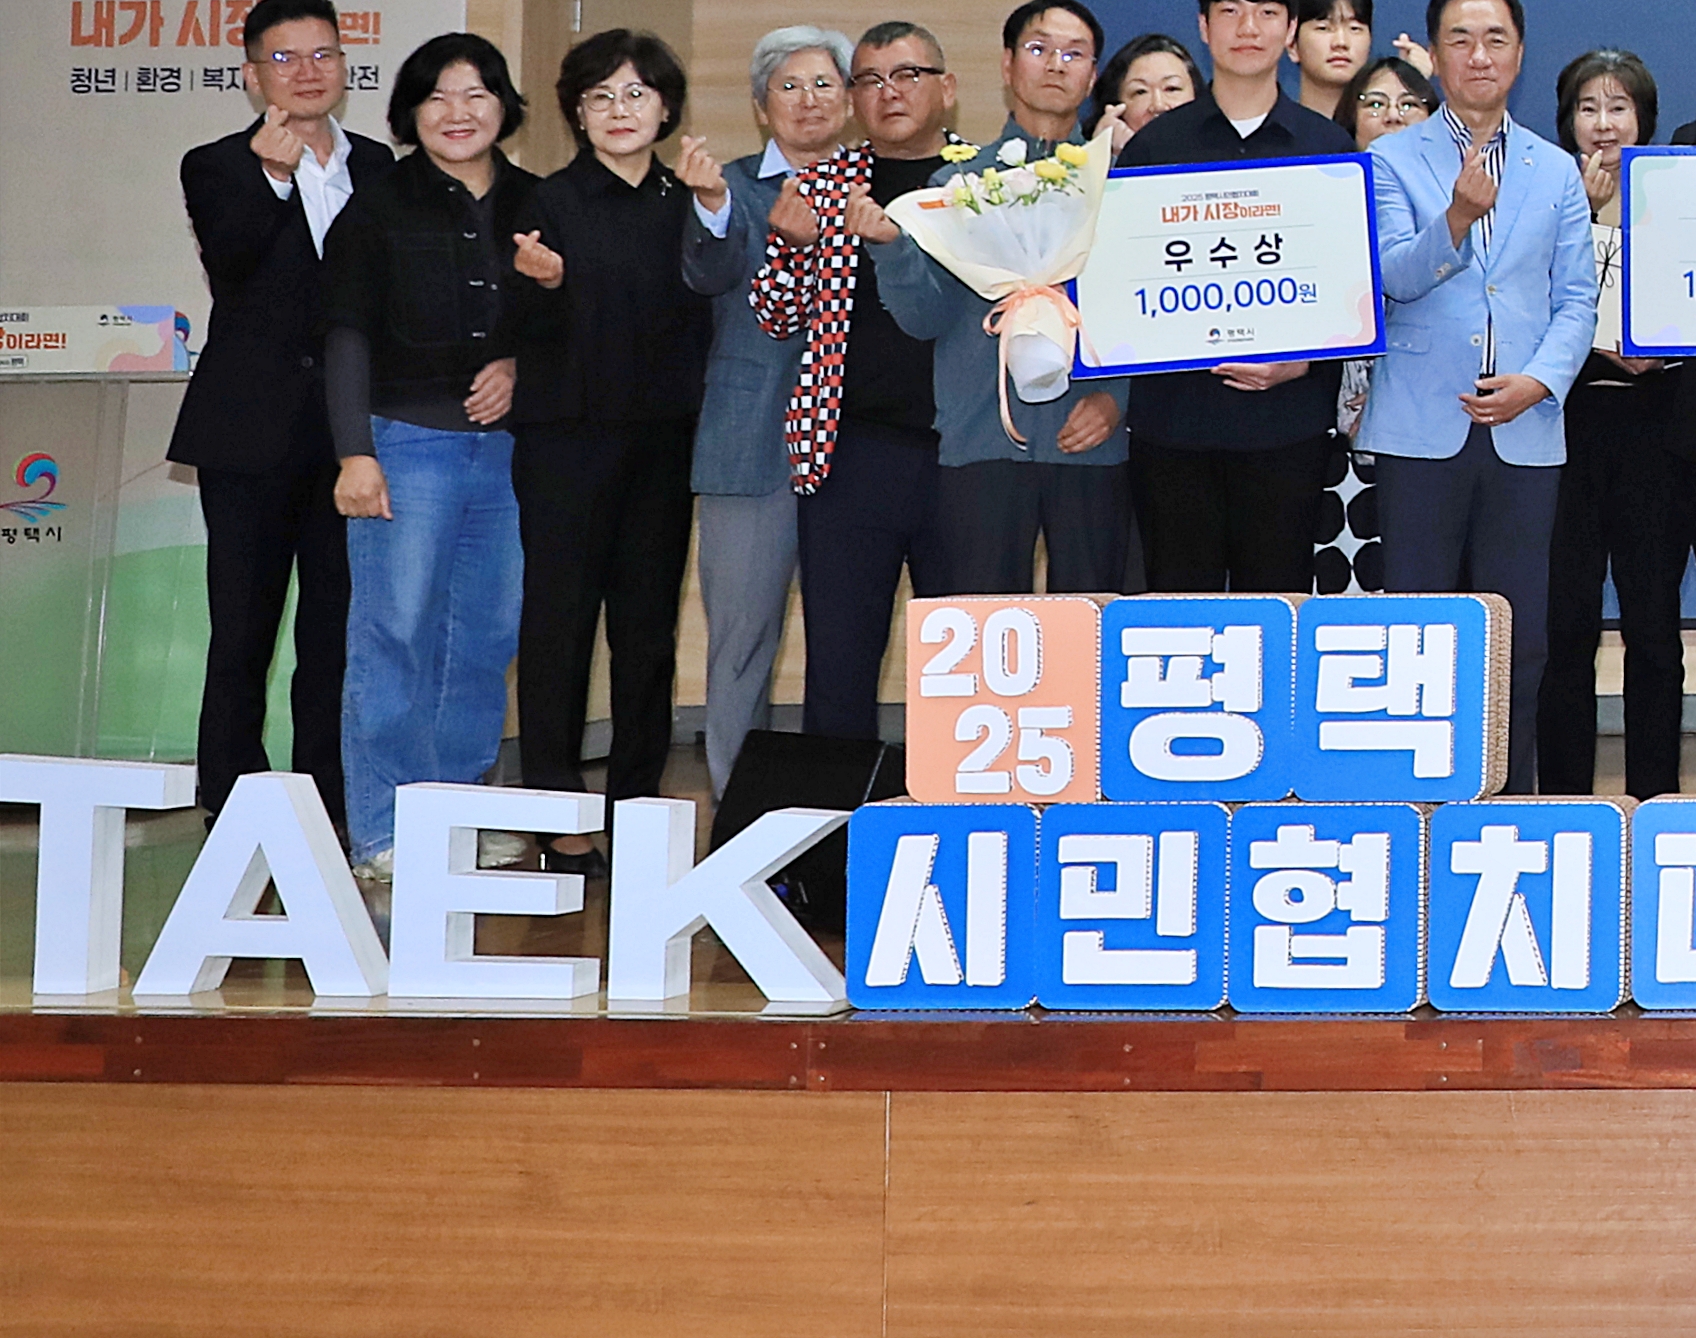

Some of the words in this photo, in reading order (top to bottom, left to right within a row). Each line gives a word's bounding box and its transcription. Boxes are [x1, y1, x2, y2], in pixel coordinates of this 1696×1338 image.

[70, 0, 164, 47] 내가
[70, 67, 117, 94] 청년
[136, 66, 182, 93] 환경
[1161, 204, 1199, 224] 내가
[1134, 277, 1318, 319] 1,000,000원
[0, 327, 66, 350] 이라면!
[1, 526, 61, 545] 평택시
[0, 752, 852, 1006] TAEK
